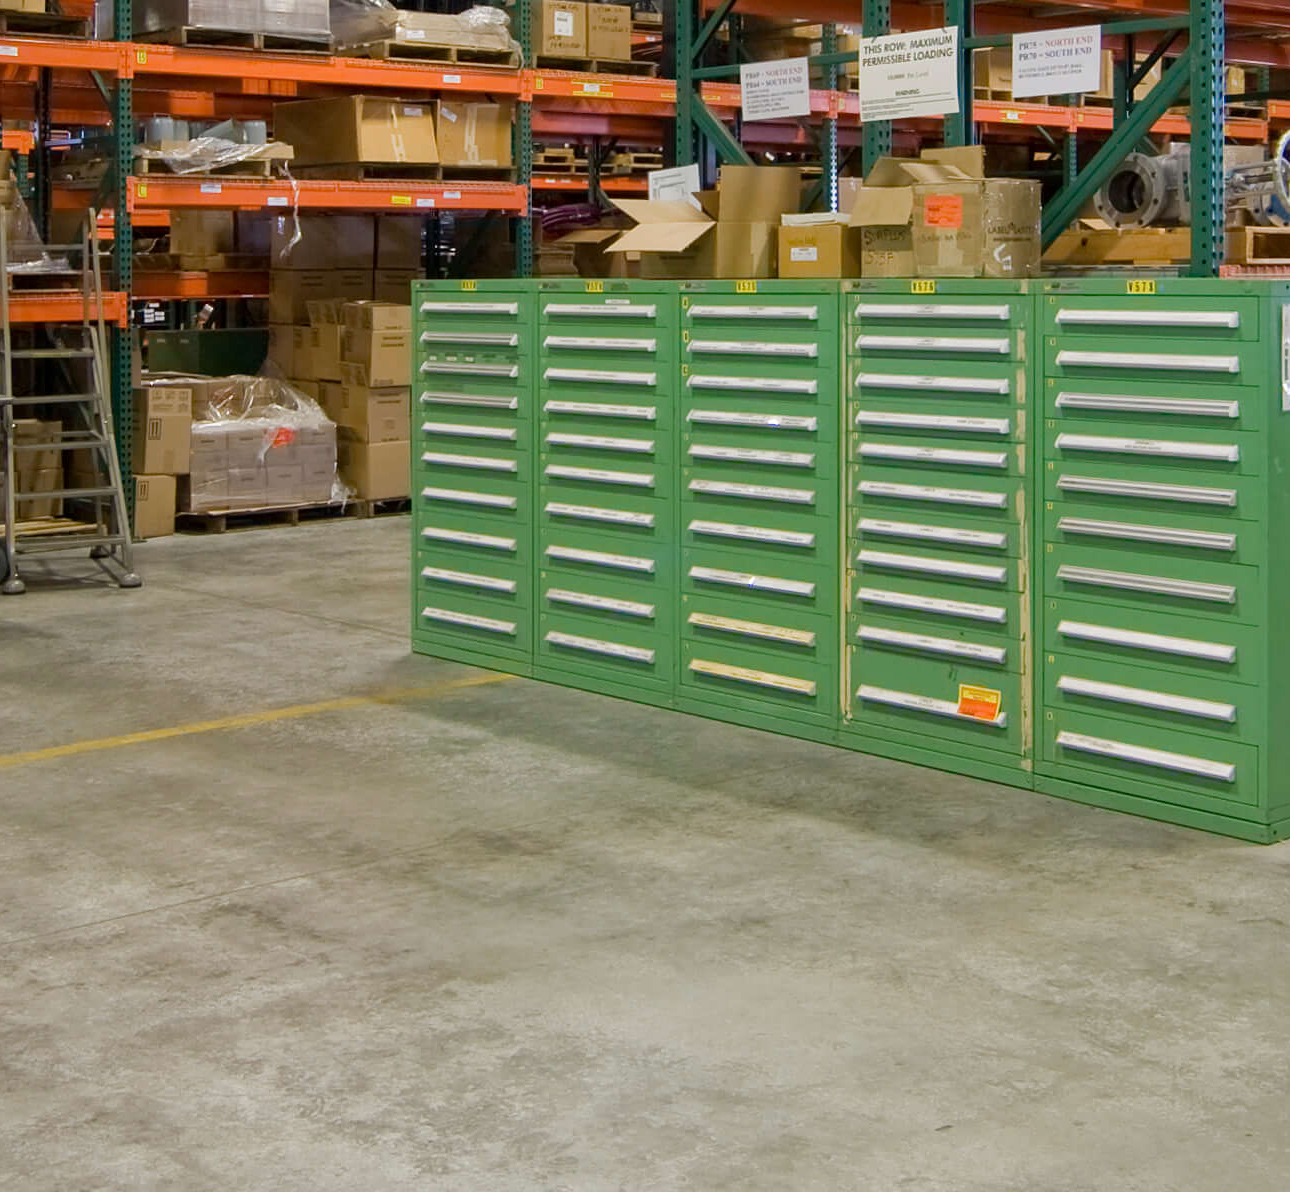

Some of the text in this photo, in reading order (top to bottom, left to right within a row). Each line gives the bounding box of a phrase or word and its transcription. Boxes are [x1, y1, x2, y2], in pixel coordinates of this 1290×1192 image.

[863, 43, 882, 55] THIS
[910, 34, 953, 48] MAXIMUM
[1045, 36, 1074, 48] NORTH
[1076, 35, 1093, 45] END
[862, 47, 954, 67] PERMISSIBLE LOADING
[1045, 48, 1072, 59] SOUTH
[1075, 47, 1092, 56] END
